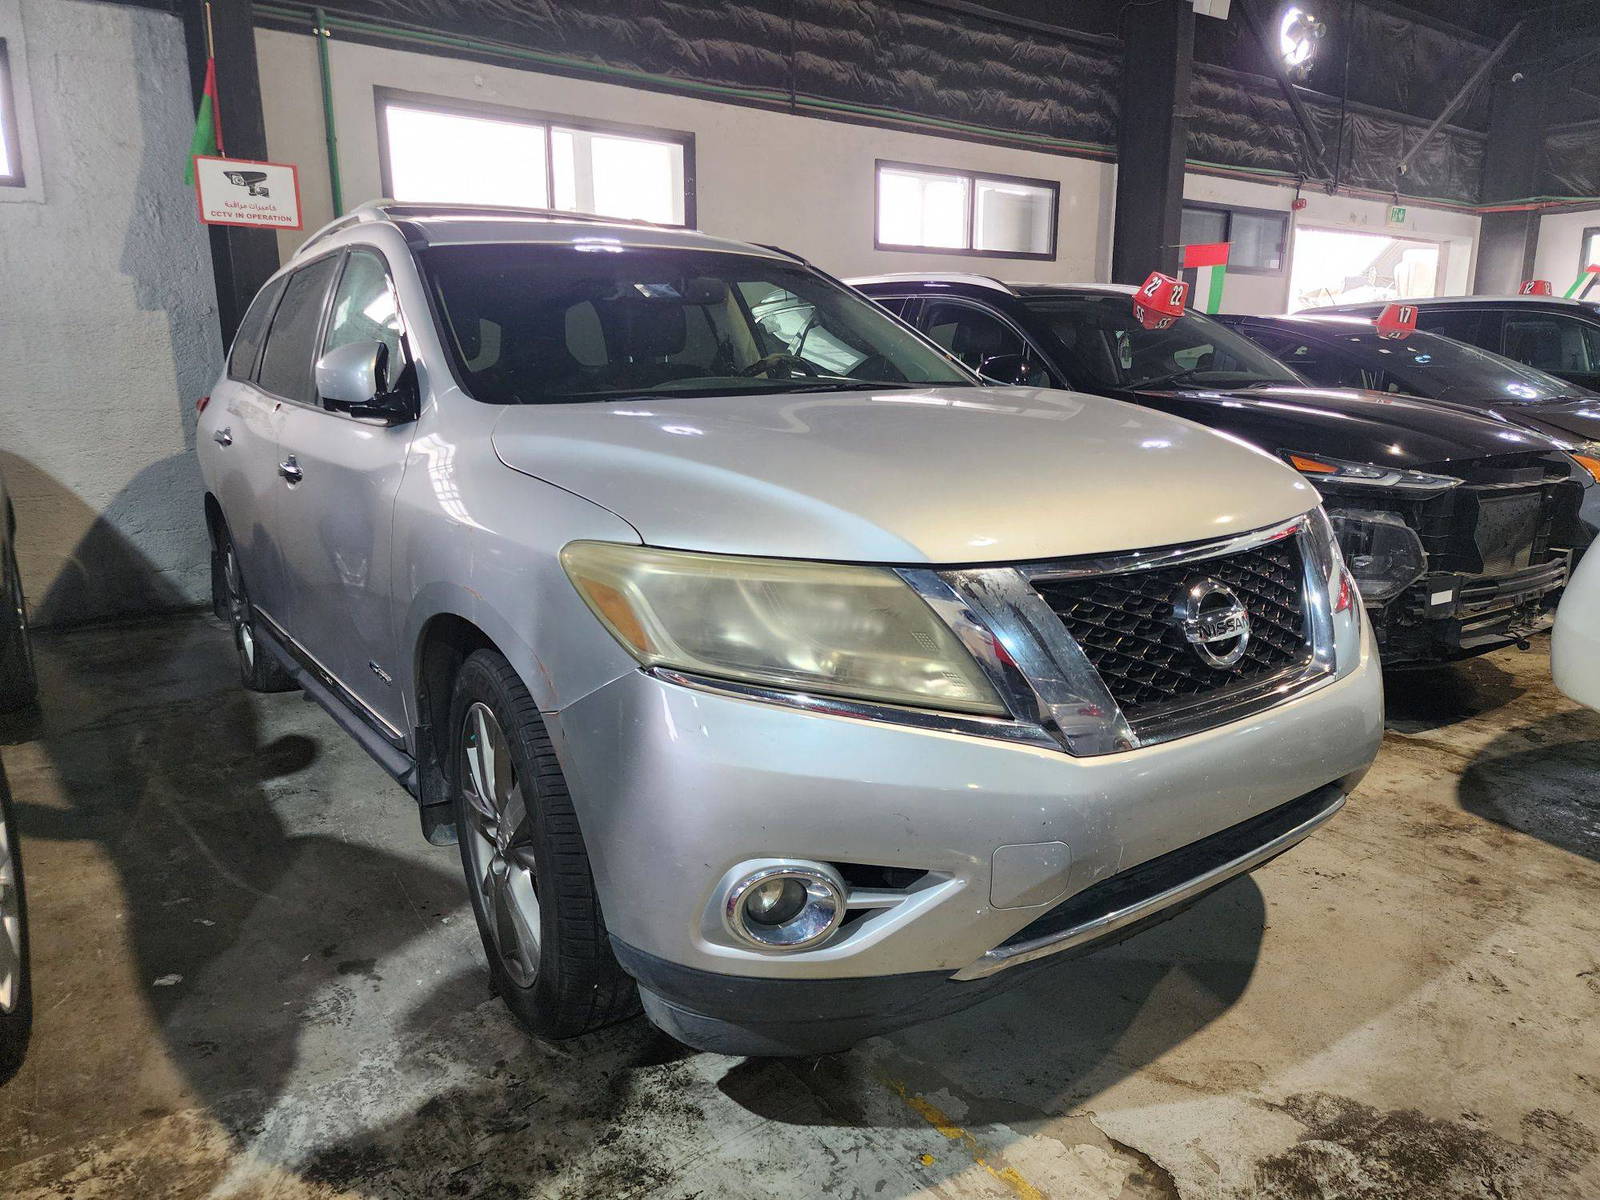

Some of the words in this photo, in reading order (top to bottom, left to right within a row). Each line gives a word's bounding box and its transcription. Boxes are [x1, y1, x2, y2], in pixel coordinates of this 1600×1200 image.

[246, 214, 293, 222] OPERATION
[1143, 276, 1163, 297] 22
[1170, 285, 1184, 306] 22
[1399, 306, 1411, 323] 17
[1200, 617, 1249, 638] NISSAN
